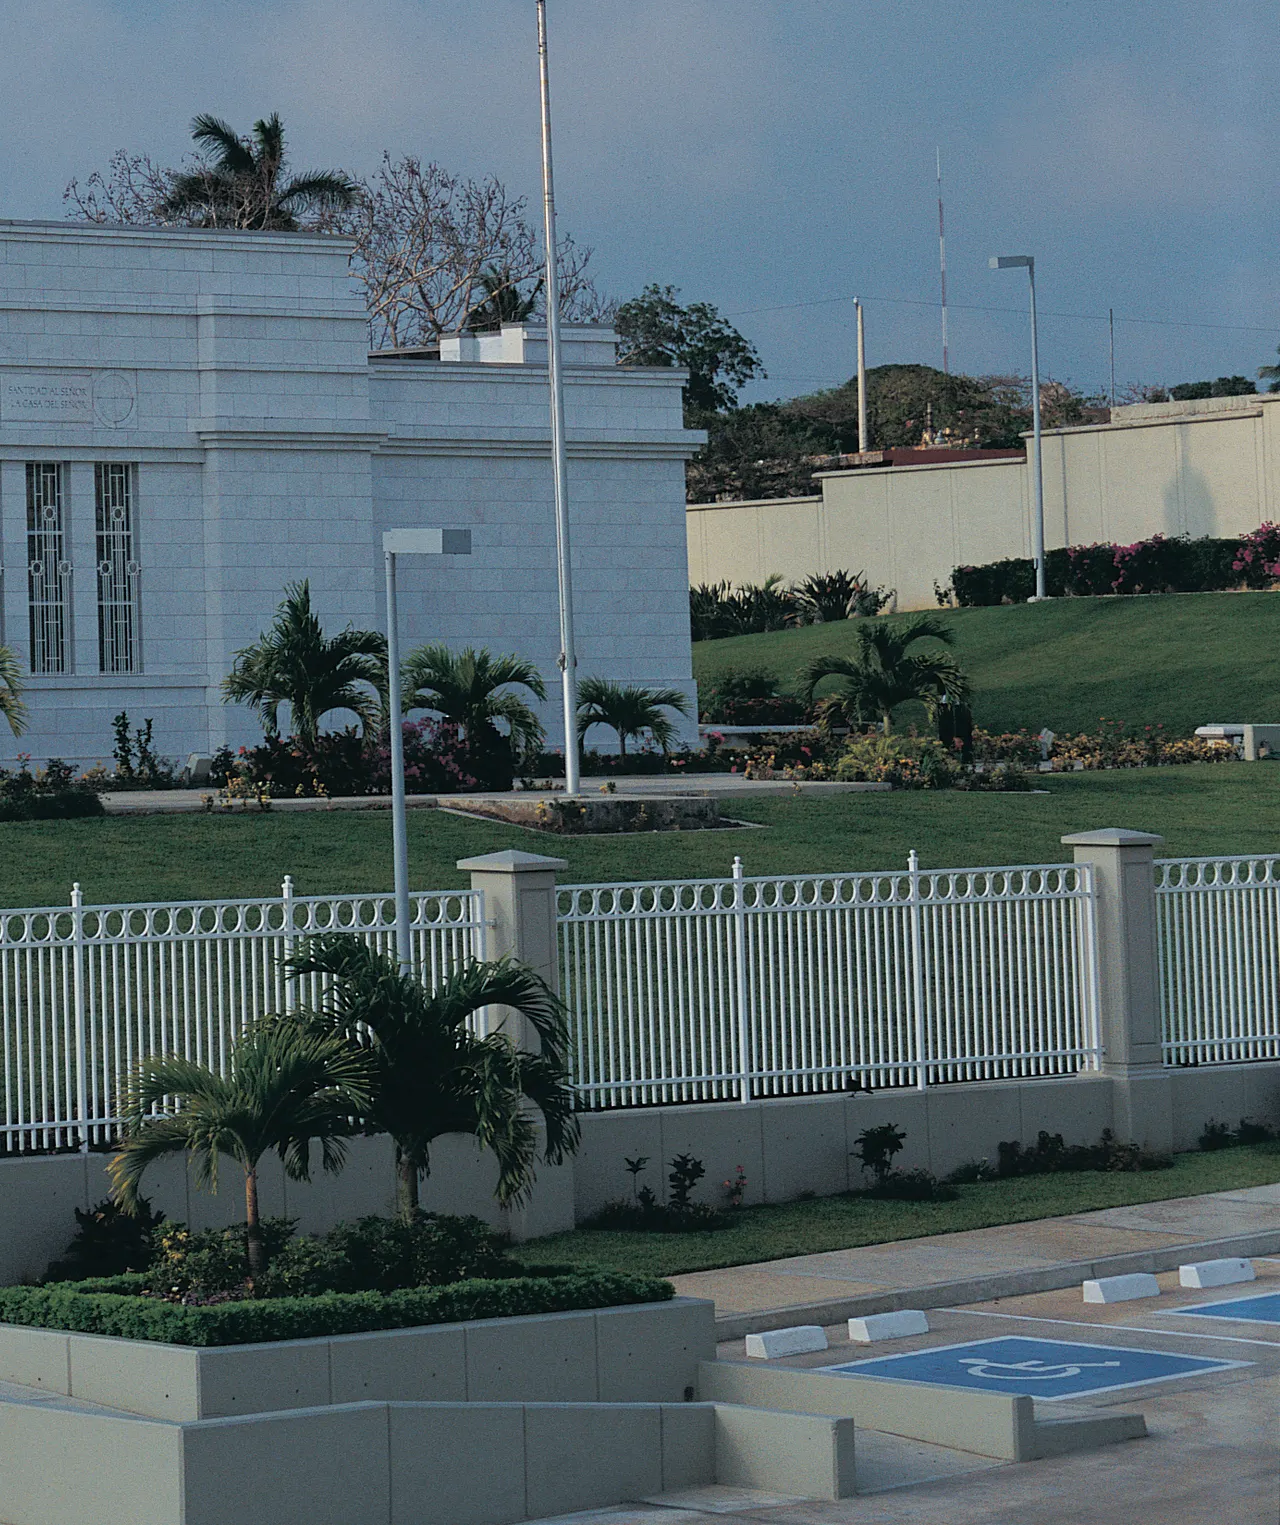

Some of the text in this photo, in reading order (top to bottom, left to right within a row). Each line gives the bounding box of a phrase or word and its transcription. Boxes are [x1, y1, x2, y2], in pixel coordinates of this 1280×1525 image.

[8, 385, 47, 396] SANTIDAD
[50, 387, 60, 396] AL
[22, 399, 43, 408] CASA
[44, 400, 59, 409] DEL
